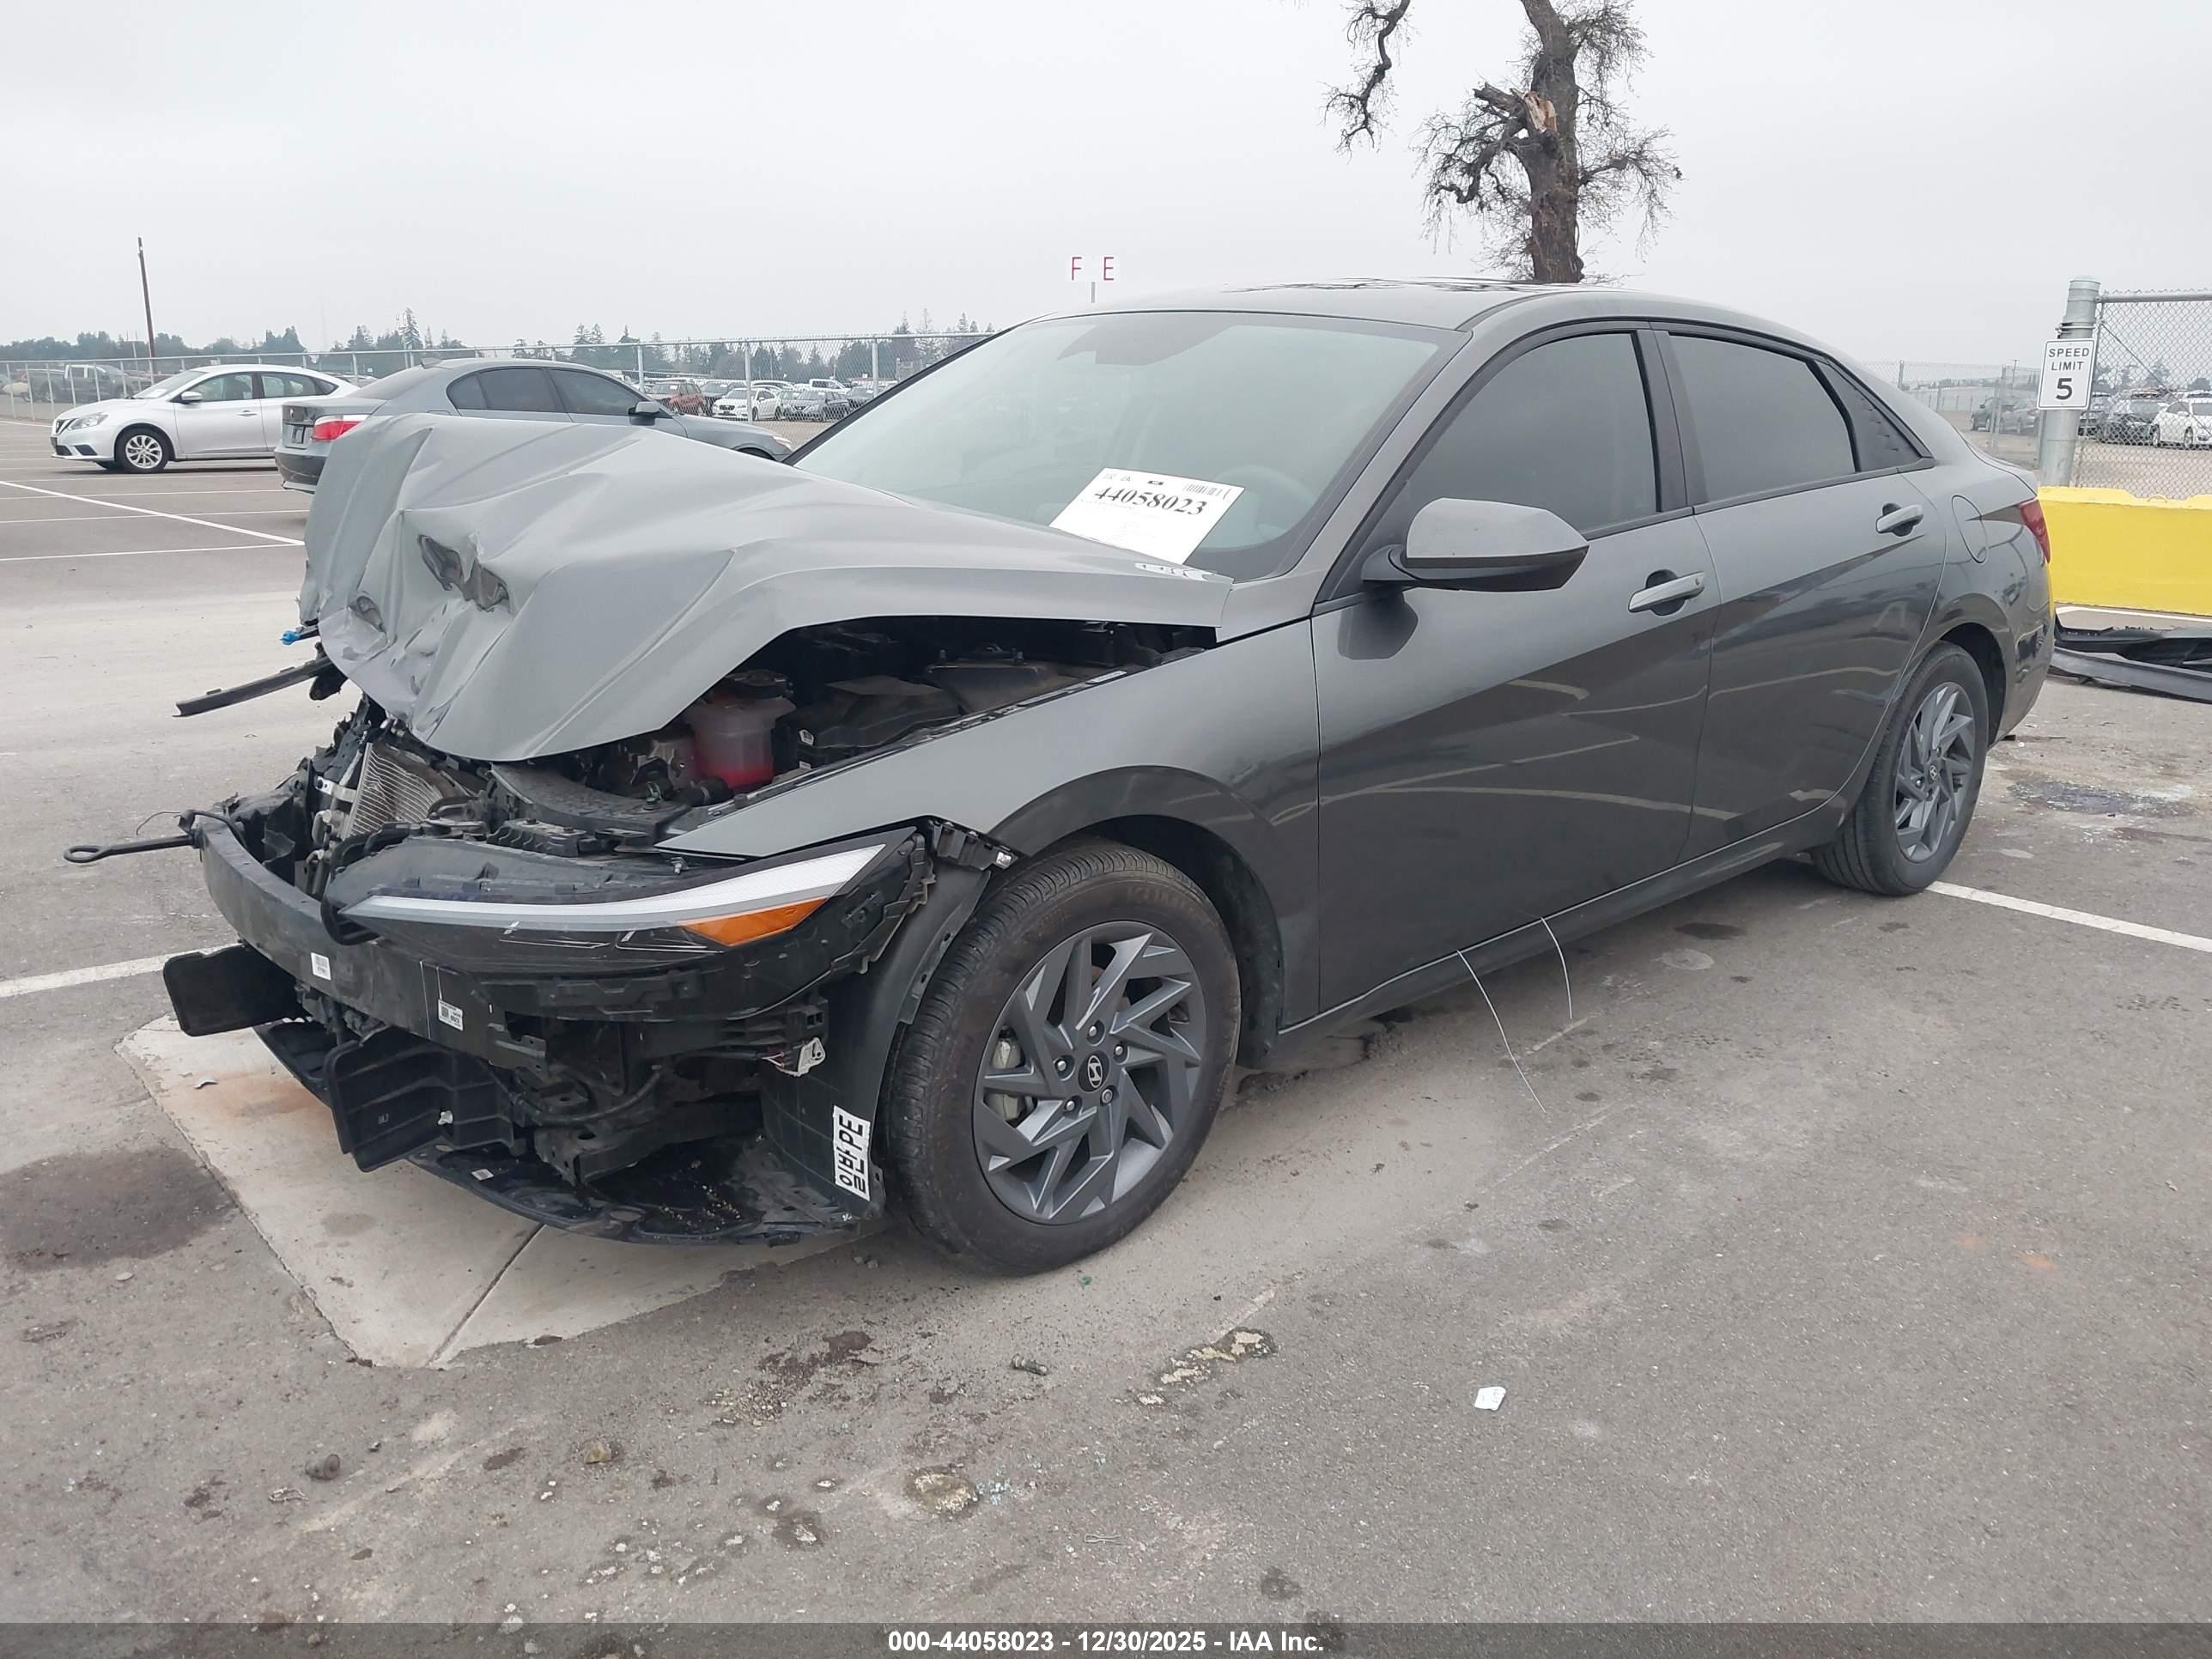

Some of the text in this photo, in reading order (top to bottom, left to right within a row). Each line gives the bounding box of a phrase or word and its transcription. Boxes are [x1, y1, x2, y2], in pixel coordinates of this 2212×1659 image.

[1071, 256, 1115, 281] F E
[2048, 347, 2090, 358] SPEED
[2051, 361, 2085, 371] LIMIT
[2055, 377, 2073, 401] 5
[1094, 486, 1207, 516] 44058023
[838, 1114, 864, 1152] PE
